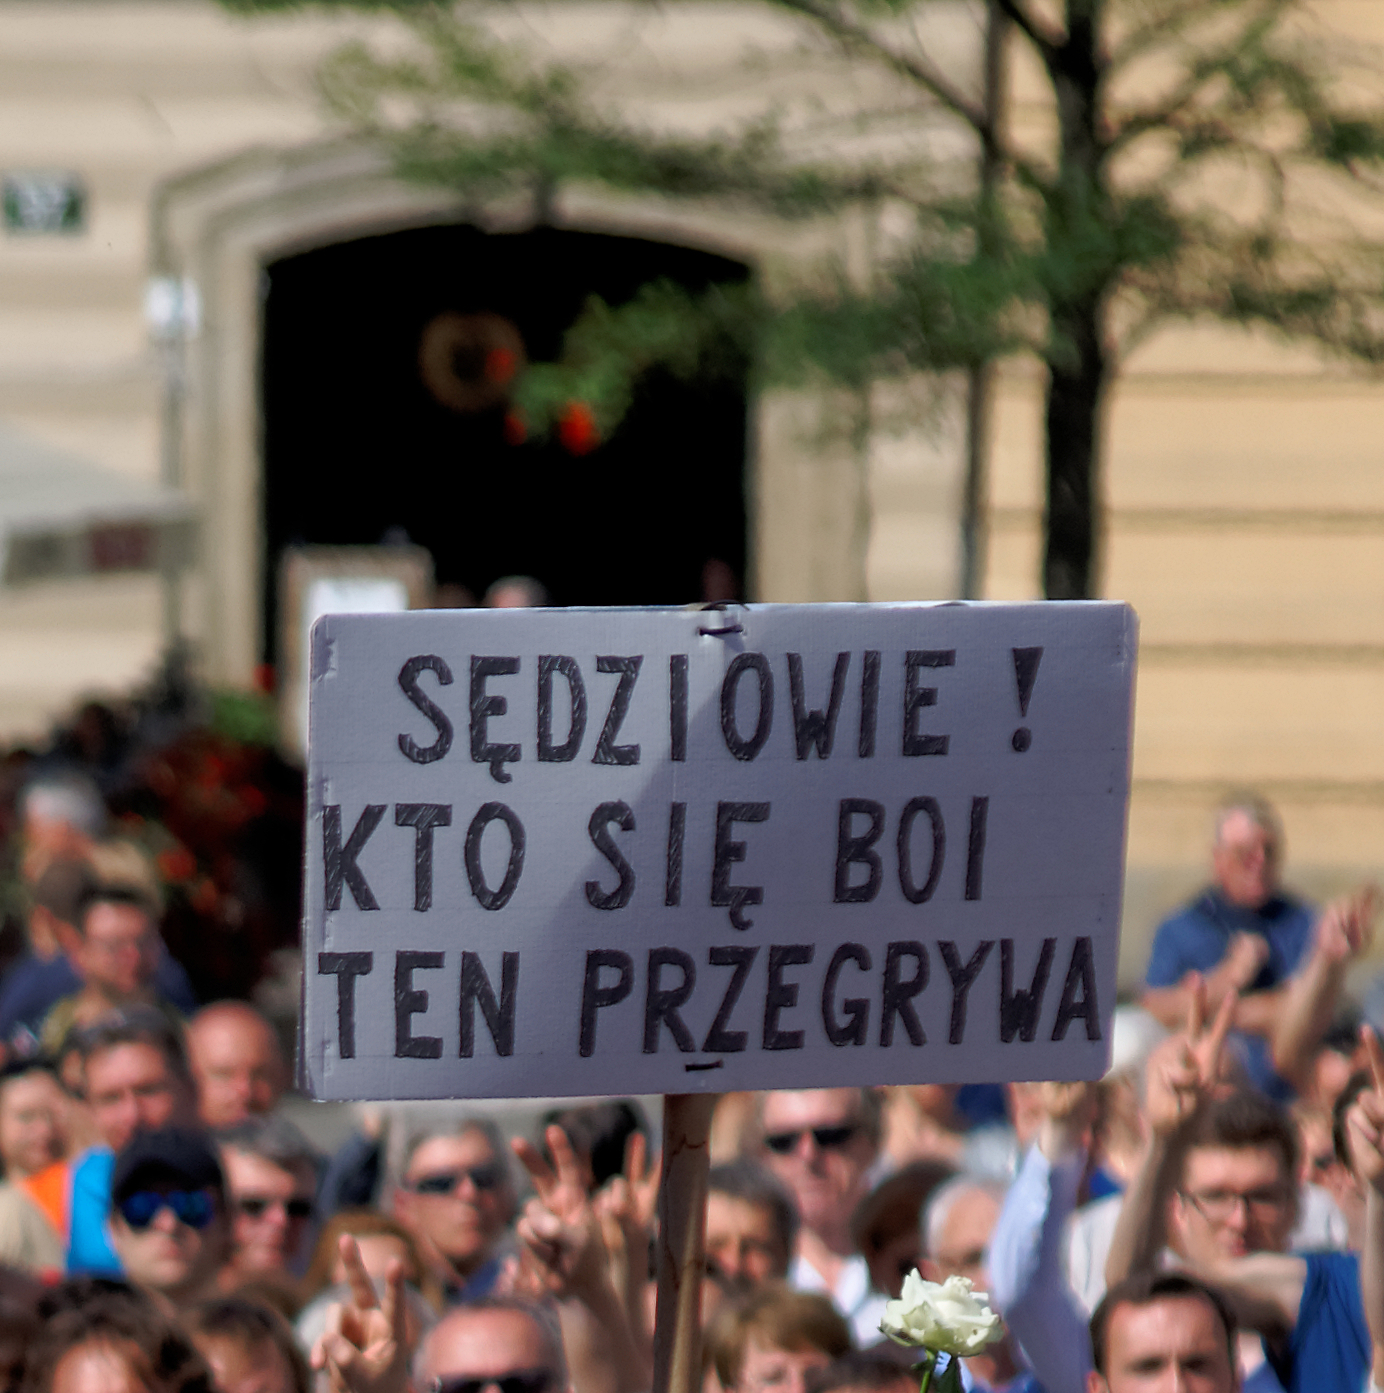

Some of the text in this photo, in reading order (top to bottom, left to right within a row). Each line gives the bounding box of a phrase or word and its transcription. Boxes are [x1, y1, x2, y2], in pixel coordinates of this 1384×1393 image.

[398, 650, 956, 783] SĘDZIOWIE
[323, 796, 990, 930] KTO SIĘ BOI
[318, 936, 1102, 1059] TEN PRZEGRYWA
